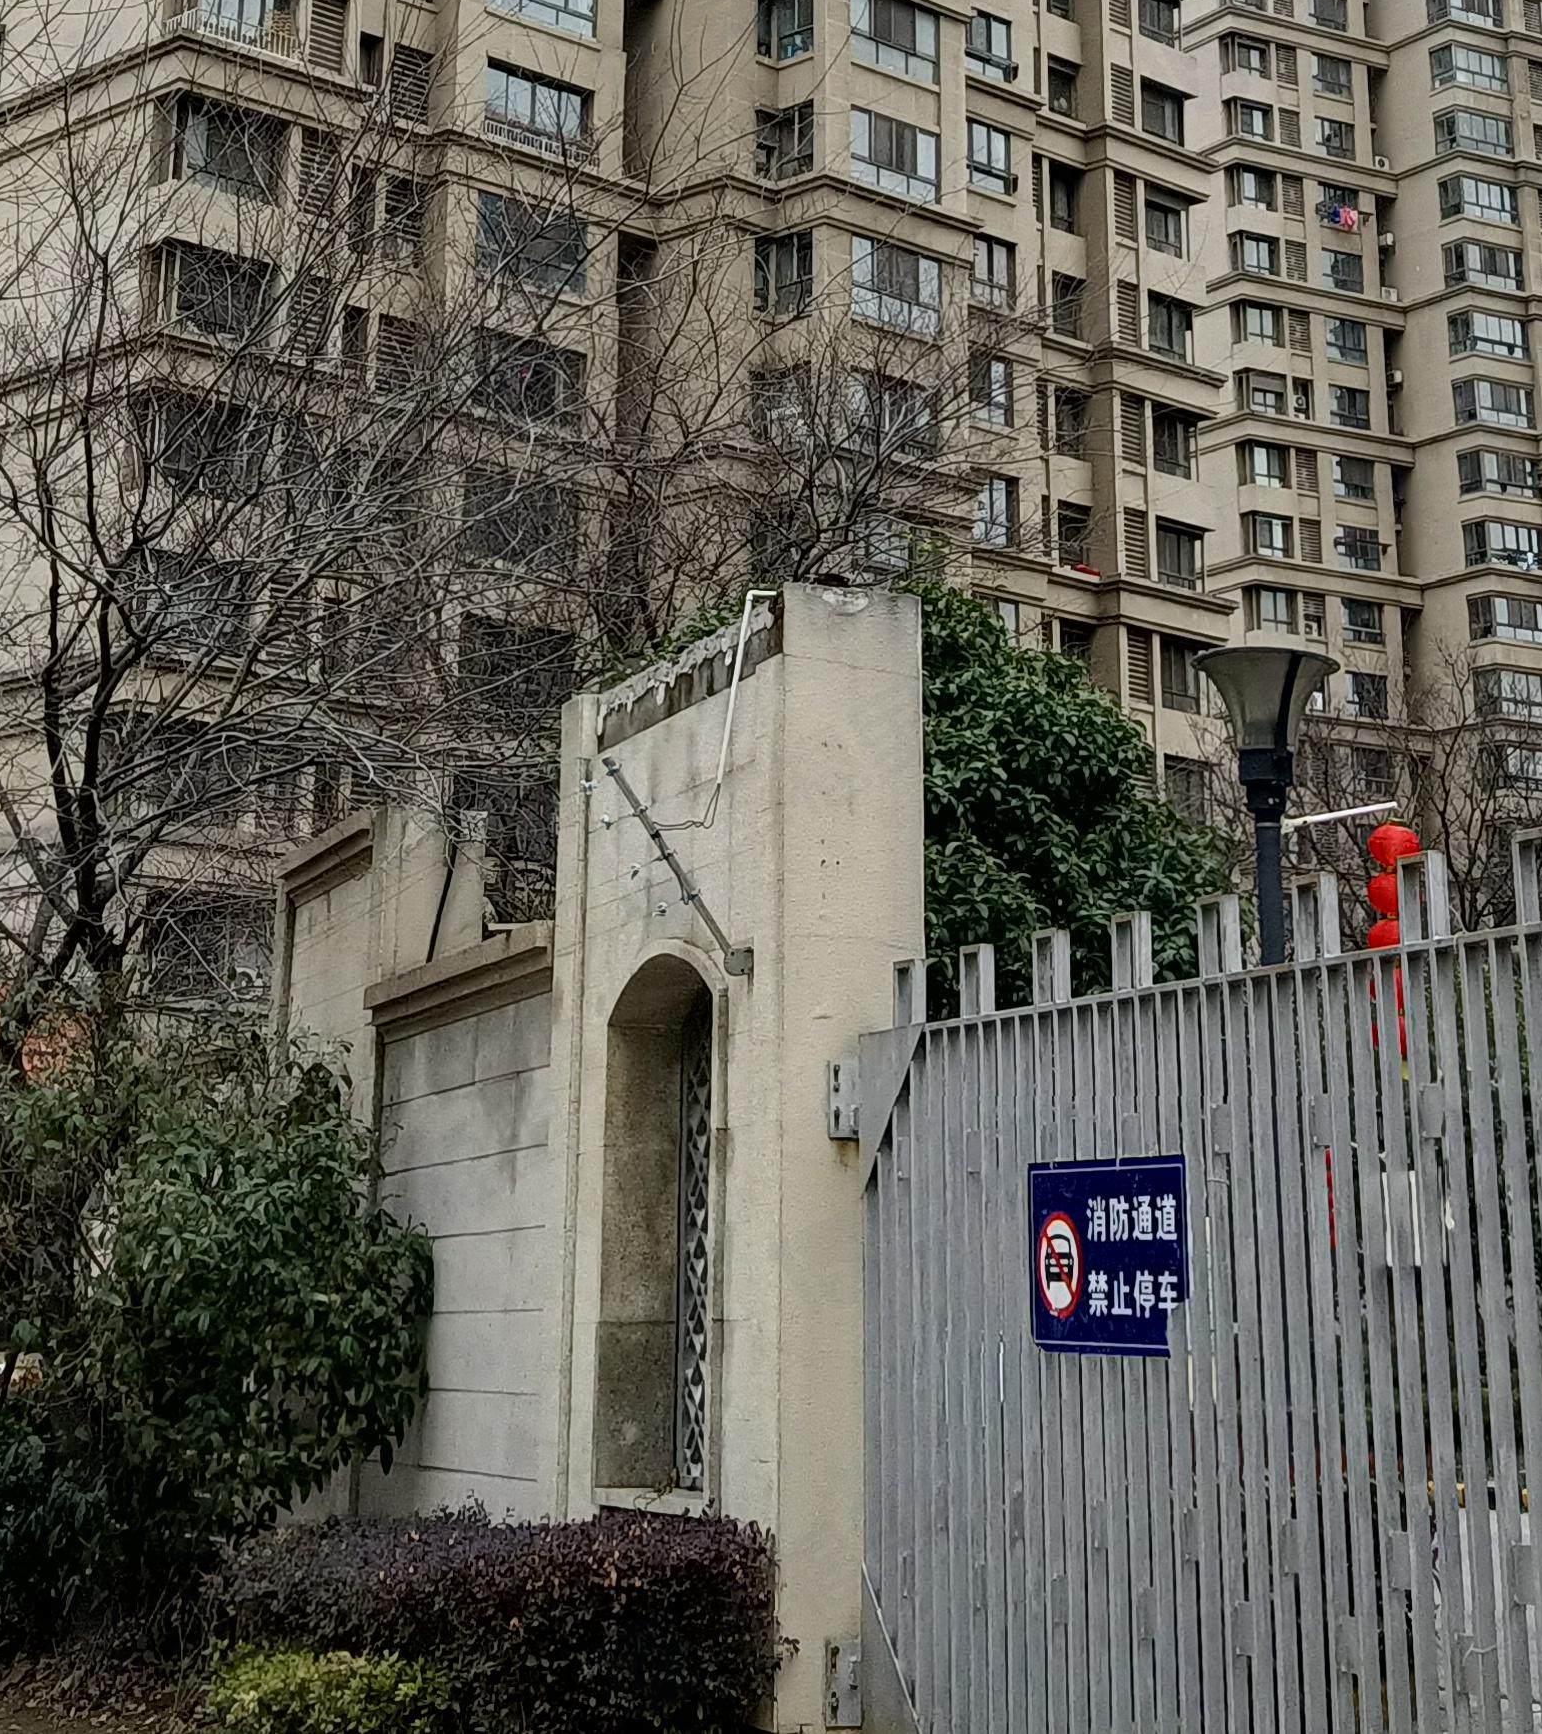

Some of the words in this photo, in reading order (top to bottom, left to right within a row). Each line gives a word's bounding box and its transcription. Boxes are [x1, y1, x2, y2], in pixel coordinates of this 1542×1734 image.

[1086, 1193, 1178, 1242] 消防通道
[1087, 1269, 1178, 1319] 禁止停车
